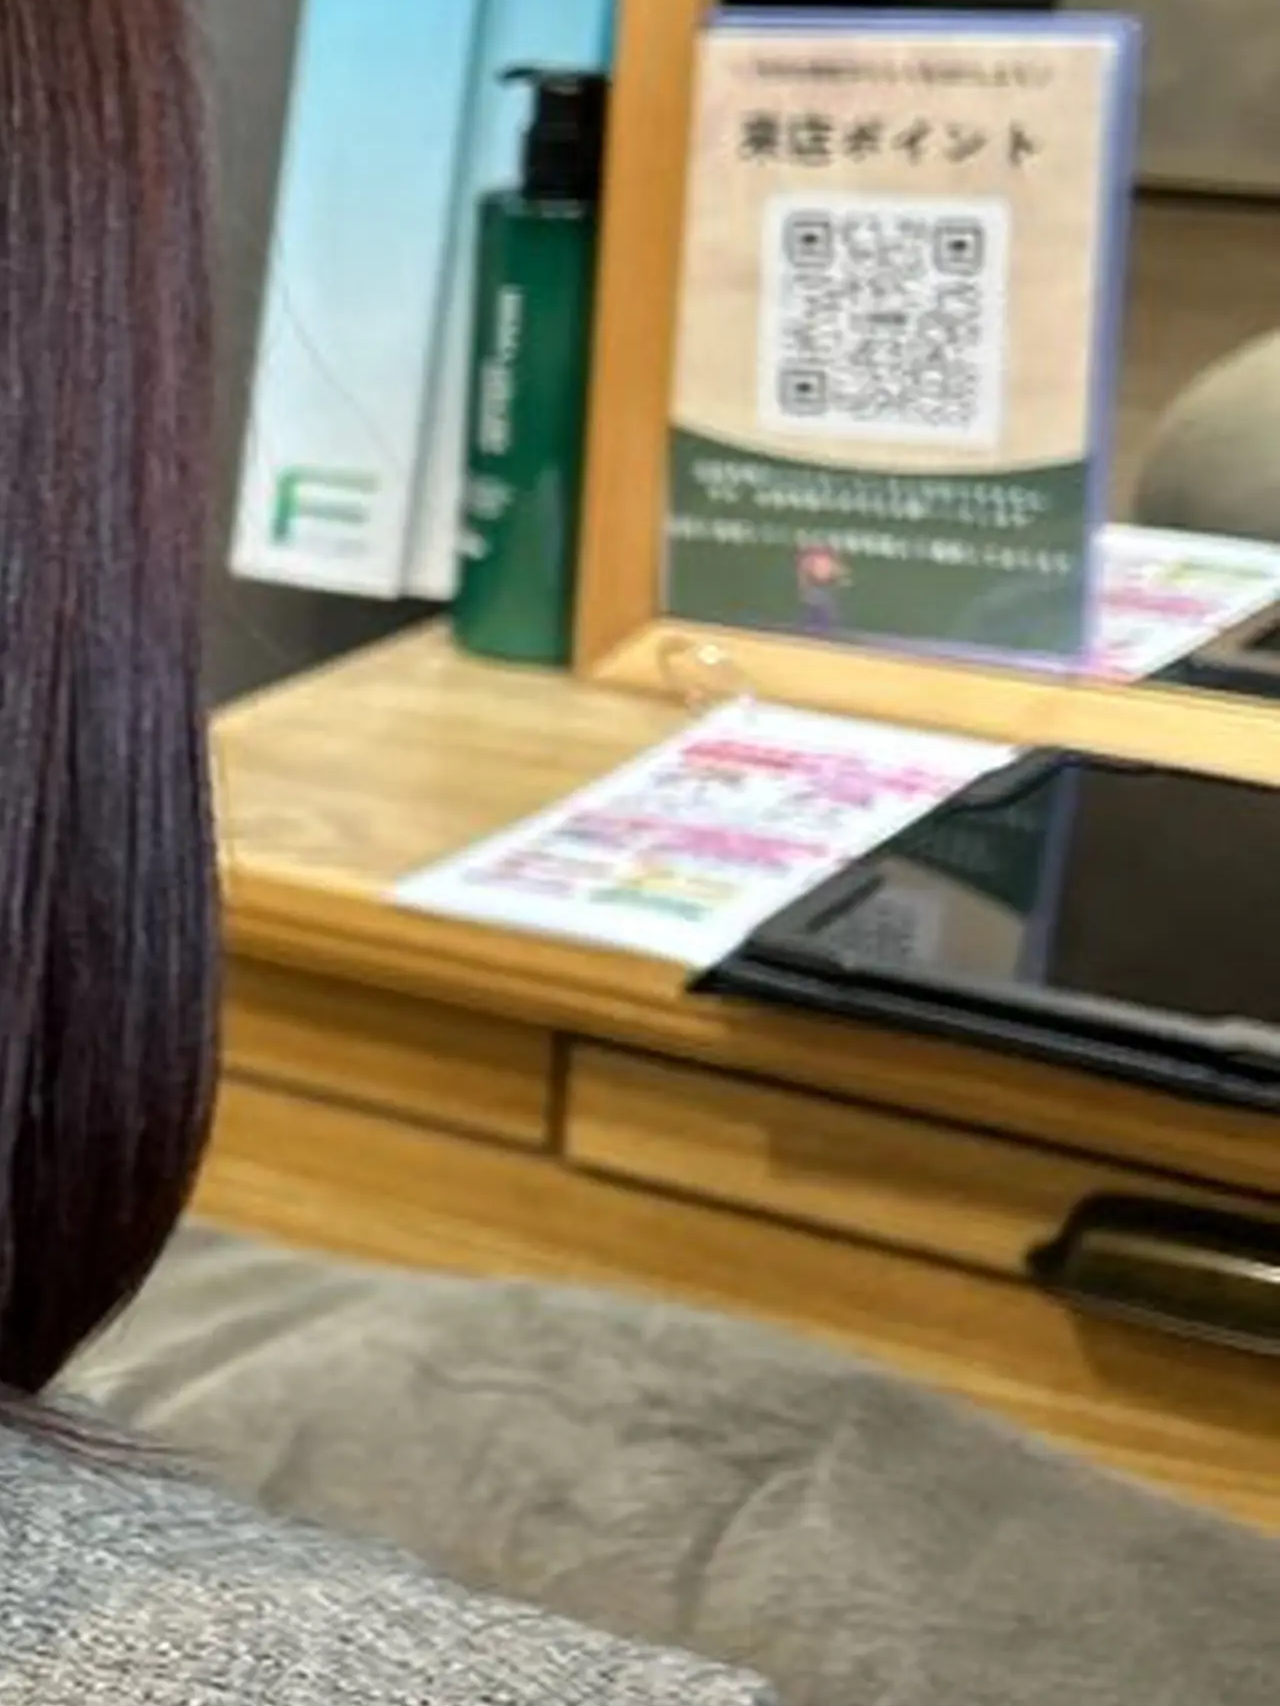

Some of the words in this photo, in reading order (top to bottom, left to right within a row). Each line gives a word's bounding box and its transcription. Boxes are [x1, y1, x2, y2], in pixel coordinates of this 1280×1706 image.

[740, 109, 1040, 167] 来店ポイント
